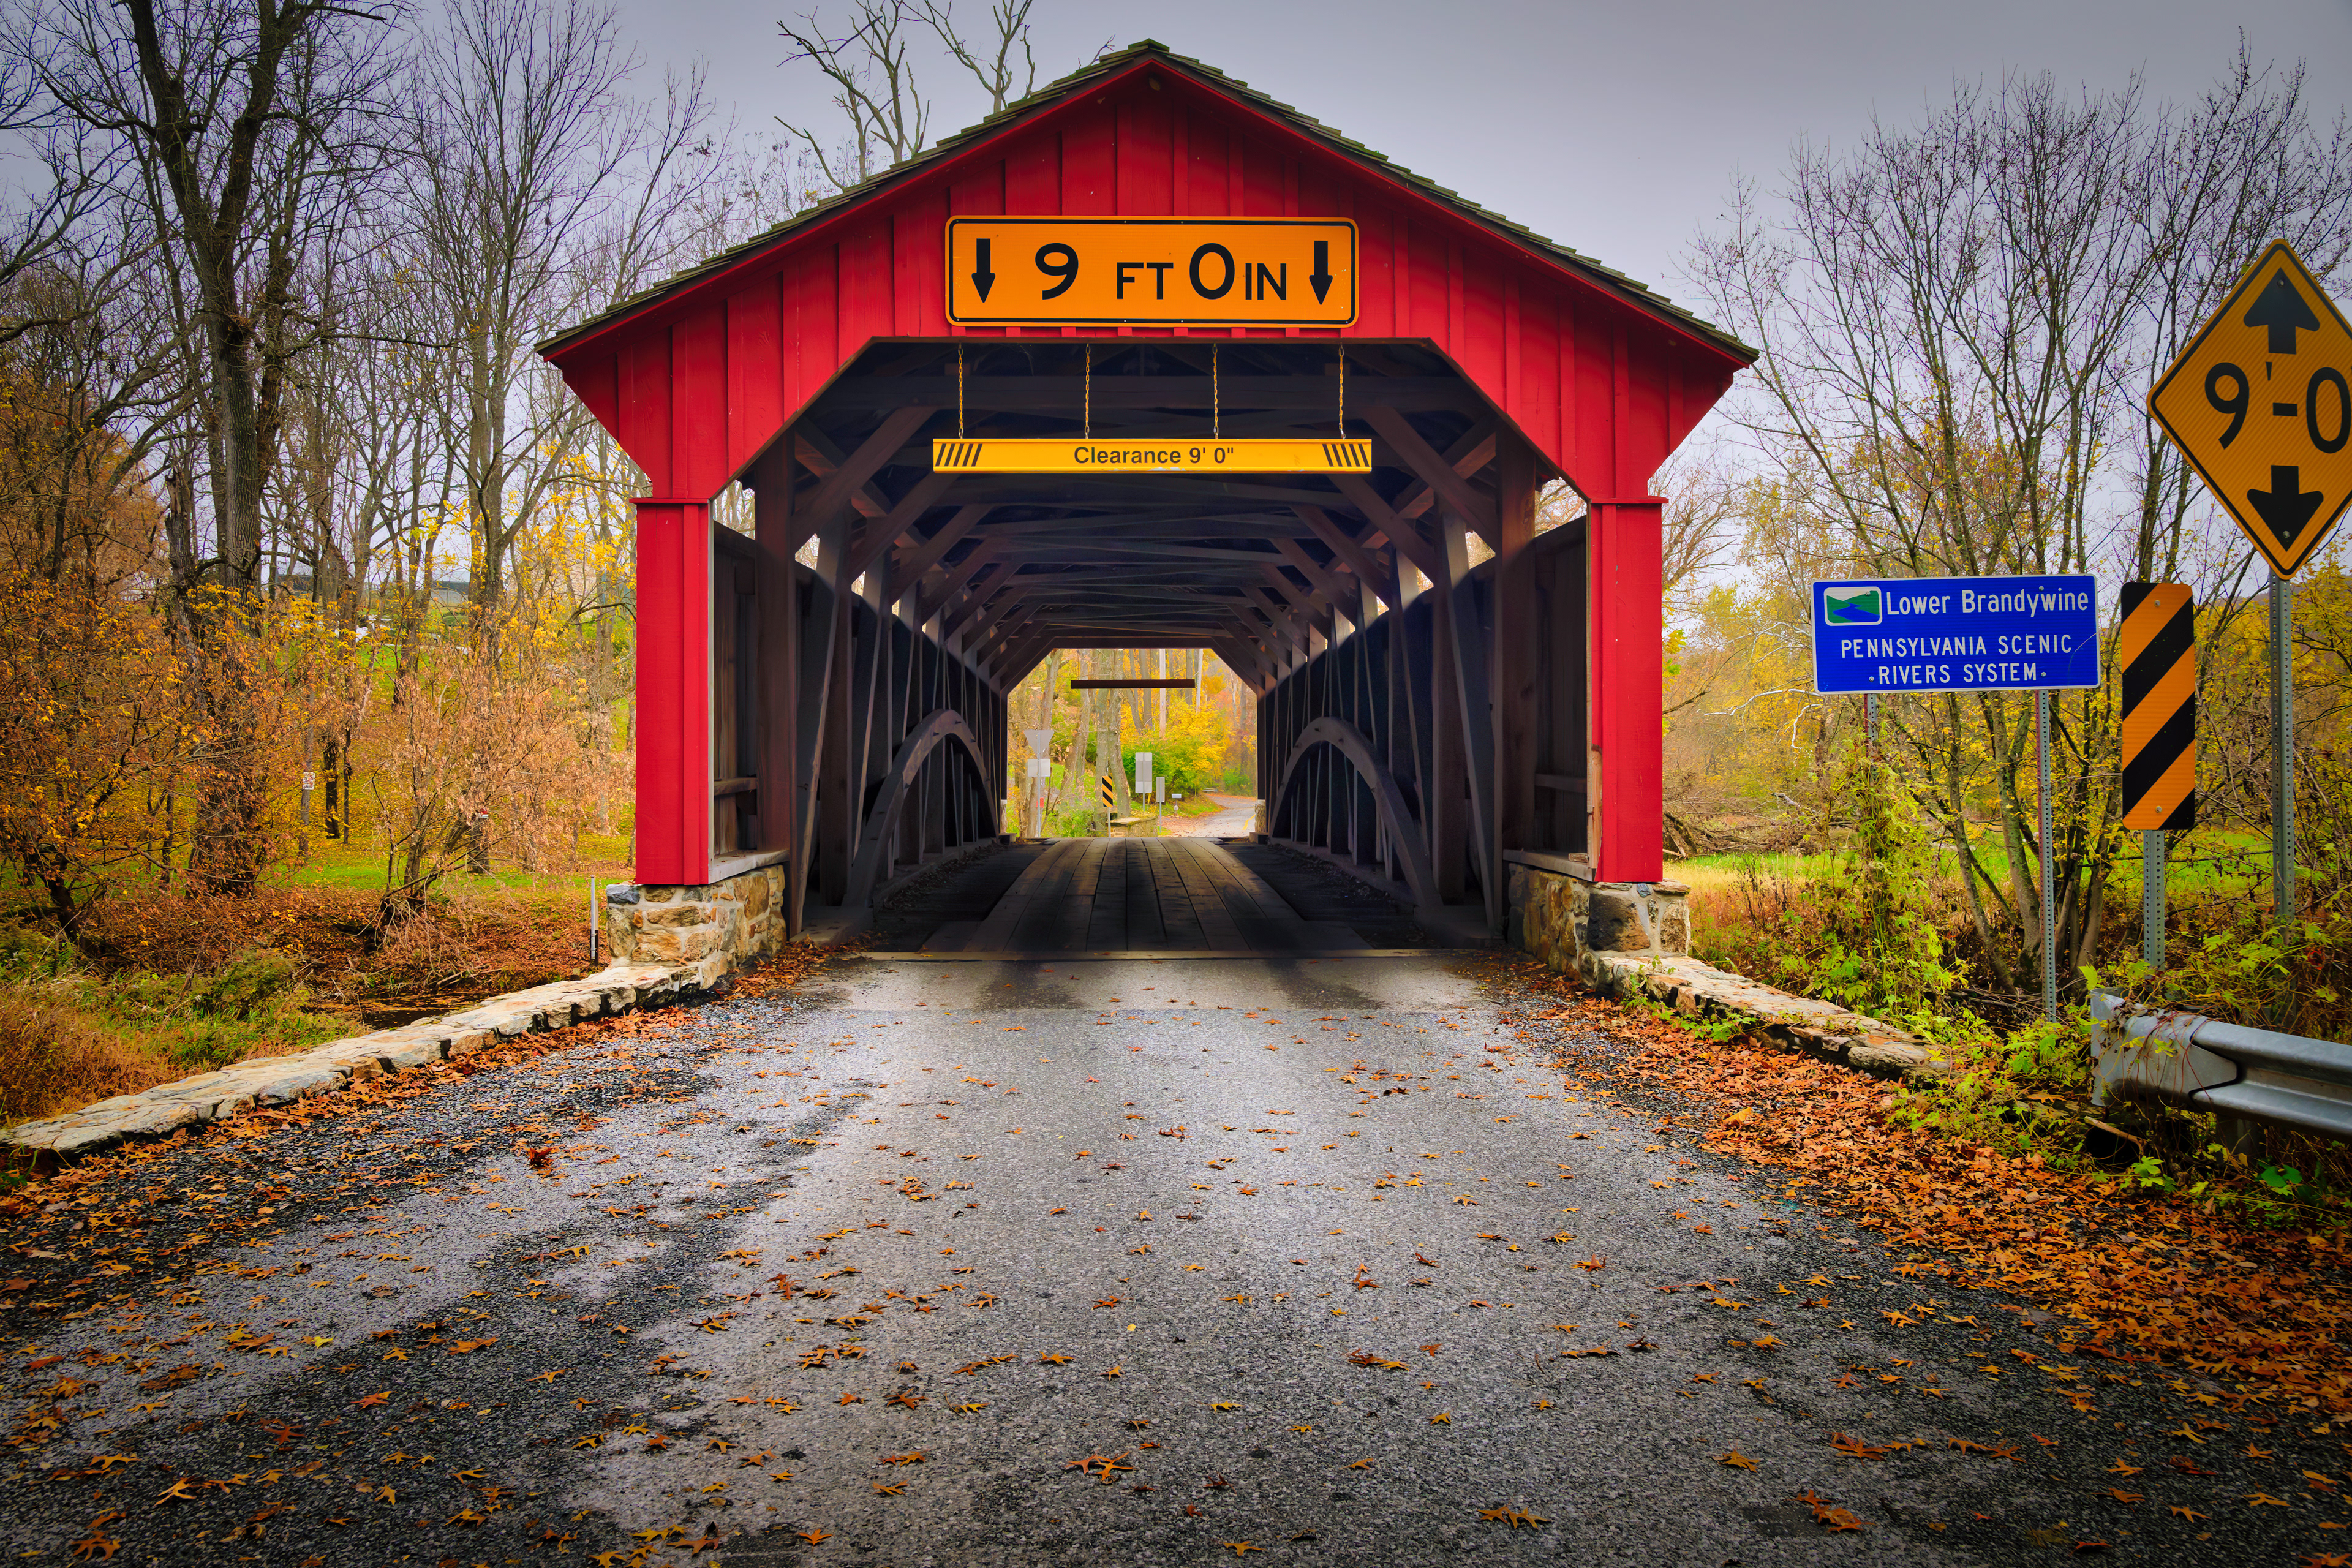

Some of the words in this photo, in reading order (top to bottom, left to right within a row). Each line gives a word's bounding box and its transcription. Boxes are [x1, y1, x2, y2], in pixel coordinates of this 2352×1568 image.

[1035, 242, 1079, 300] 9
[1117, 262, 1174, 300] FT
[2204, 361, 2352, 454] 9'-0
[1074, 445, 1182, 464] Clearance
[1189, 447, 1207, 464] 9'
[1213, 447, 1234, 464] 0"
[1887, 591, 1951, 615] Lower
[1961, 587, 2089, 617] Brandywine
[1841, 636, 1987, 658] PENNSYLVANIA
[1998, 634, 2072, 655] SCENIC
[1879, 664, 1950, 685] RIVERS
[1963, 662, 2037, 683] SYSTEM
